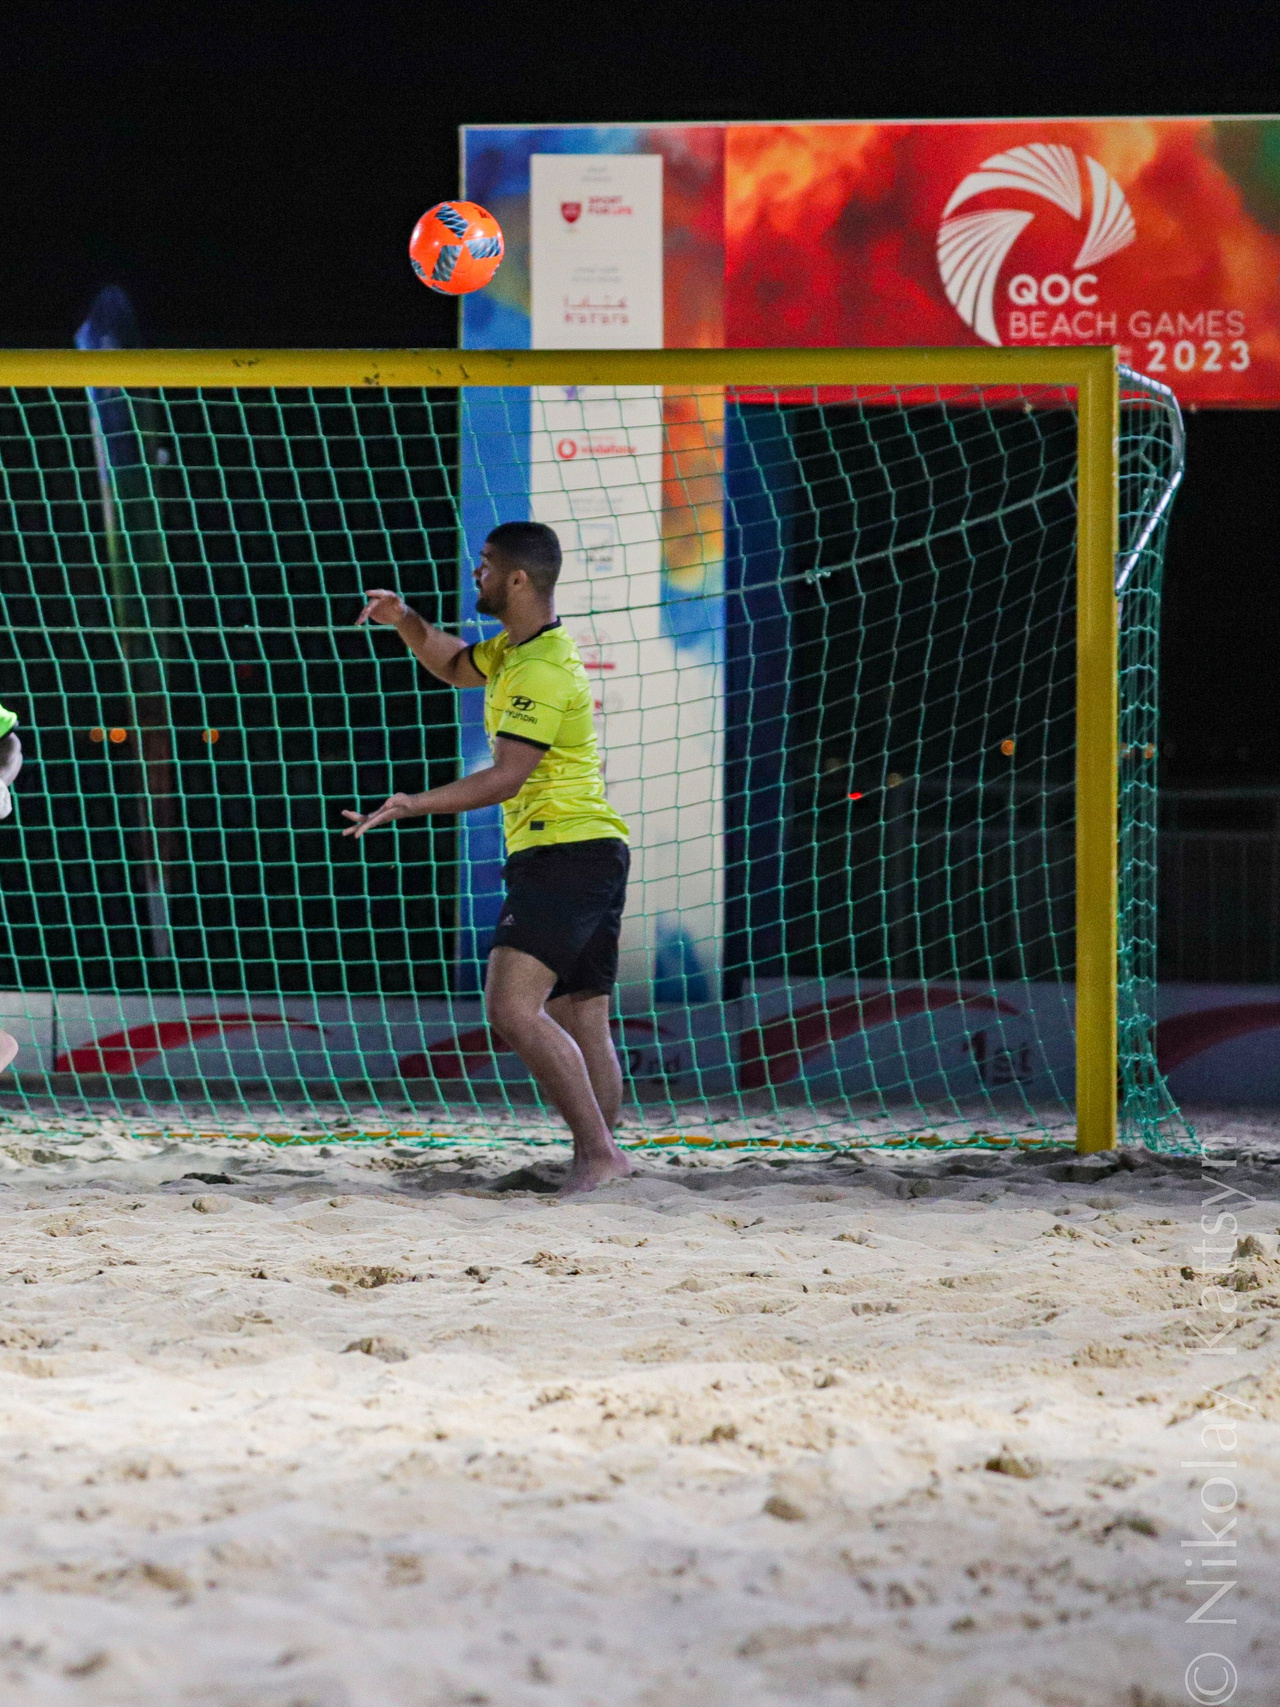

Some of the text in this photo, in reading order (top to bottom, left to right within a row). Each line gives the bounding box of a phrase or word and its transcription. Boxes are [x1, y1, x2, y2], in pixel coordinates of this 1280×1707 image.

[1008, 273, 1099, 305] QOC
[1009, 310, 1246, 339] BEACH GAMES
[1146, 339, 1251, 372] 2023
